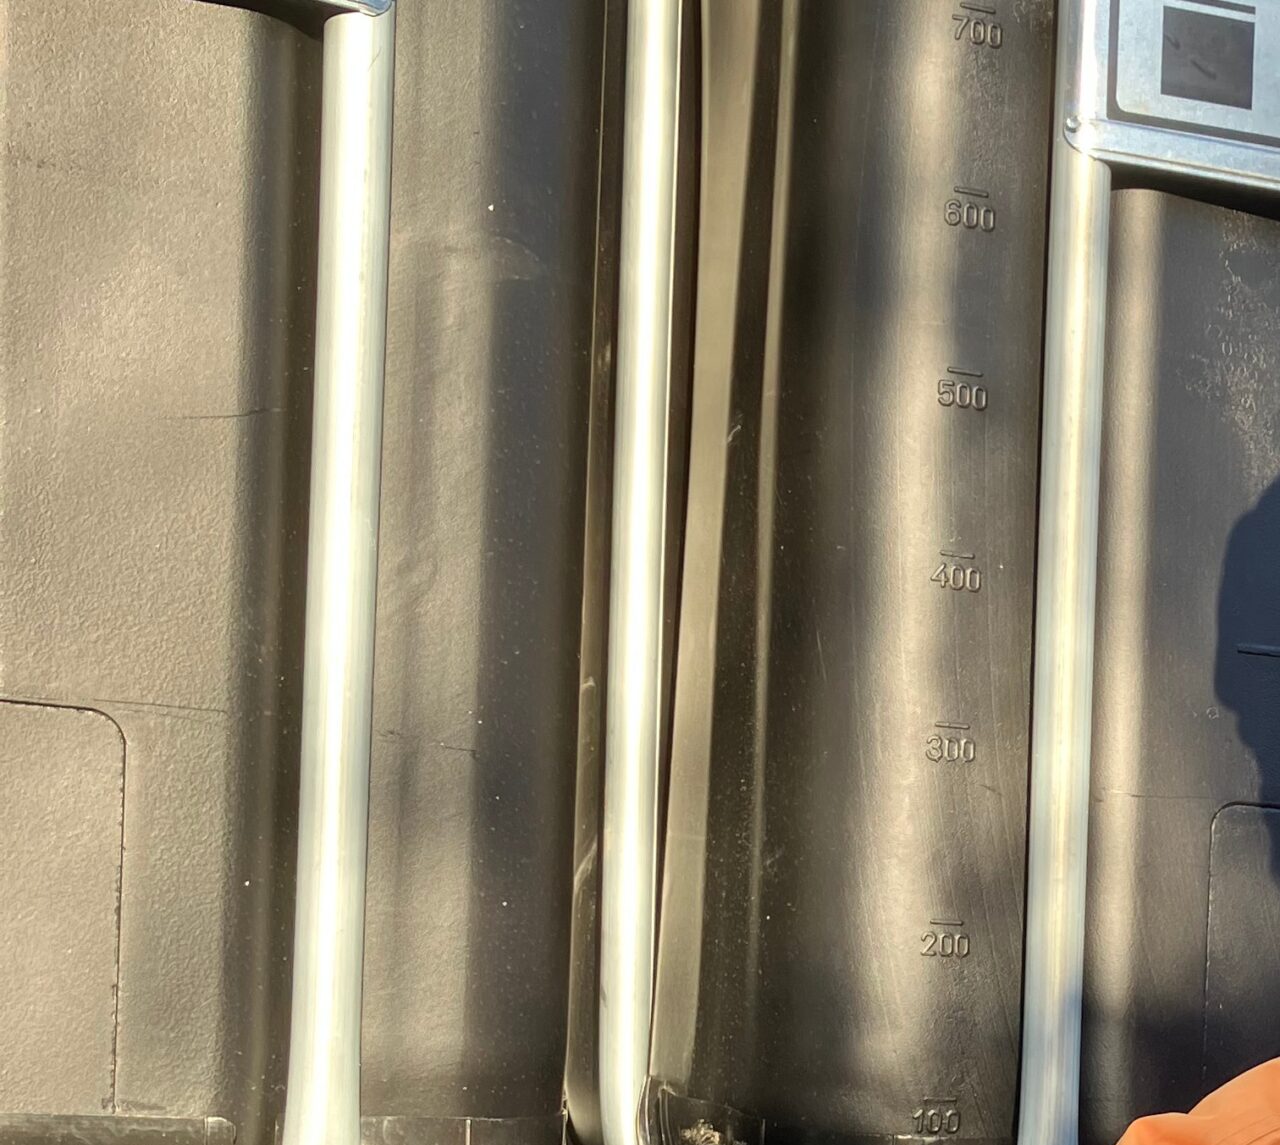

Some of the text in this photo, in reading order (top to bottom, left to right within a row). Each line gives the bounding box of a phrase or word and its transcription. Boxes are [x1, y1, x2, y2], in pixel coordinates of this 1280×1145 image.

[951, 14, 1003, 49] 700
[944, 199, 996, 232] 600
[937, 379, 988, 411] 500
[930, 563, 982, 592] 400
[925, 734, 976, 762] 300
[920, 931, 970, 958] 200
[912, 1109, 961, 1134] 100
